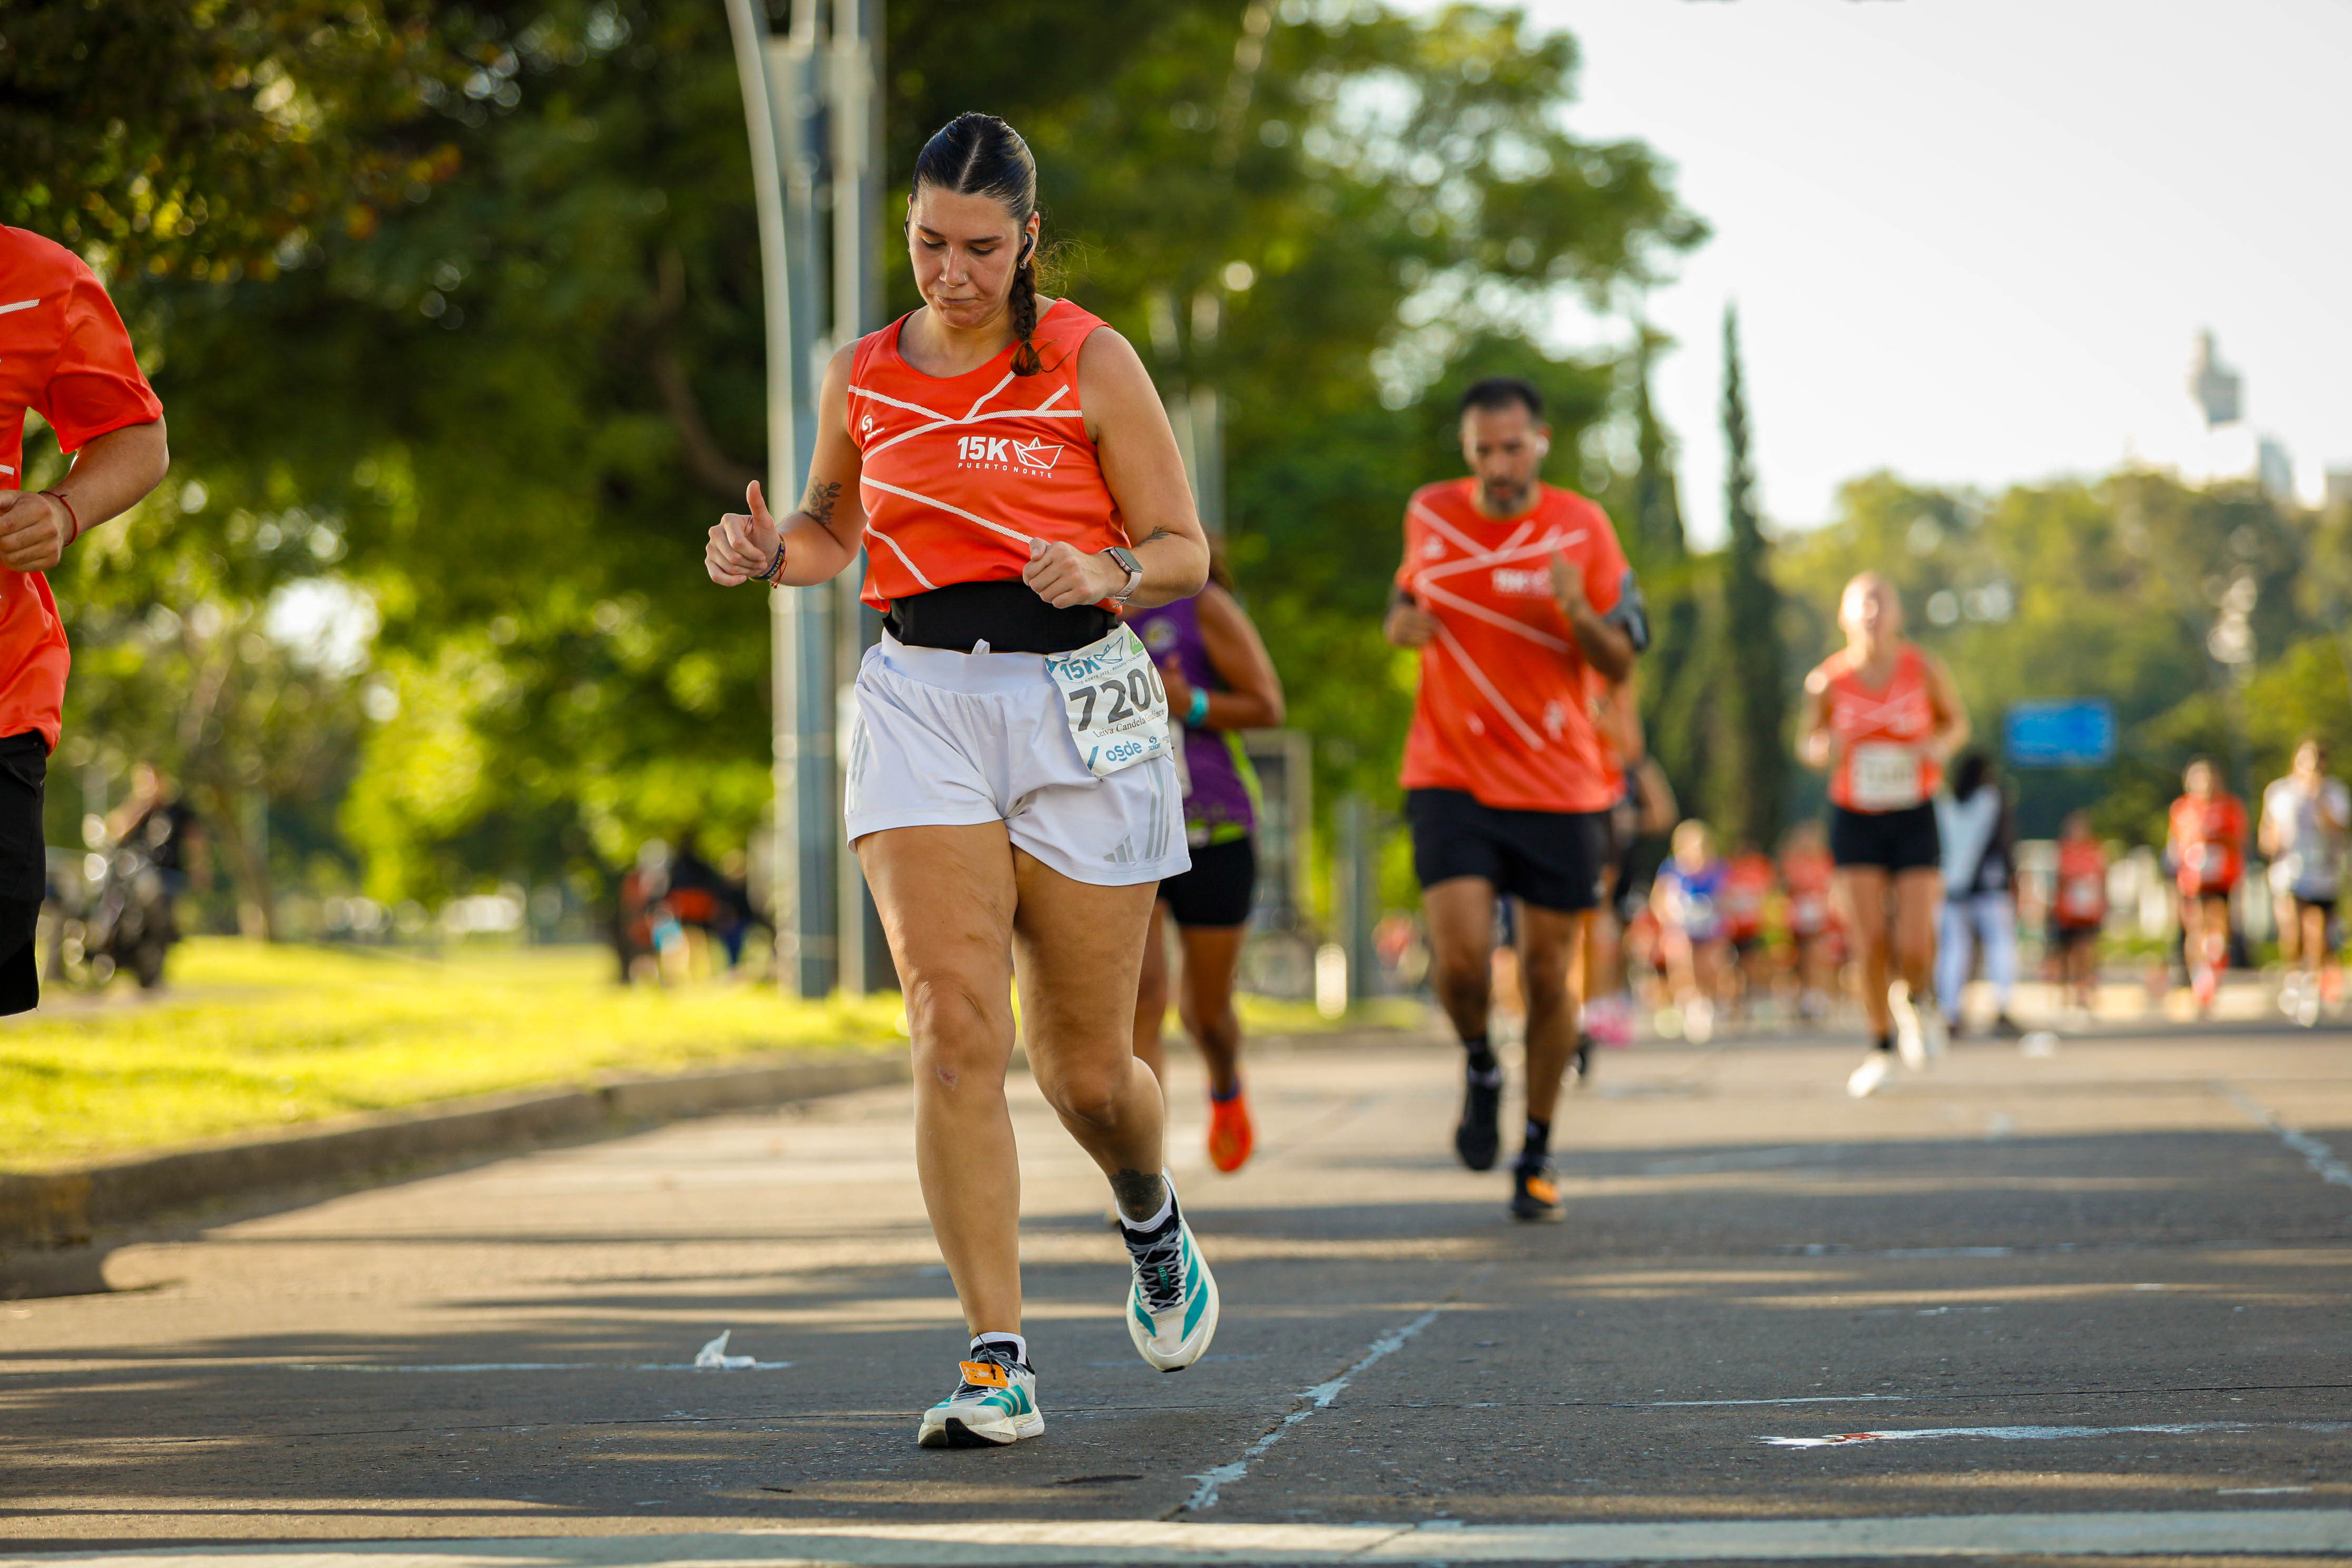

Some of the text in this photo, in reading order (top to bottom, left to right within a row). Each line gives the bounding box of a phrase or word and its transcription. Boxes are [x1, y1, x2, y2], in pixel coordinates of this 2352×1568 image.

[957, 436, 1010, 462] 15K
[958, 462, 1052, 478] PUERTO NORTE
[1060, 656, 1102, 680] 15K
[1069, 660, 1165, 732] 7200
[1093, 728, 1114, 738] Leiva
[1116, 717, 1146, 732] Candela
[1106, 740, 1142, 761] osde
